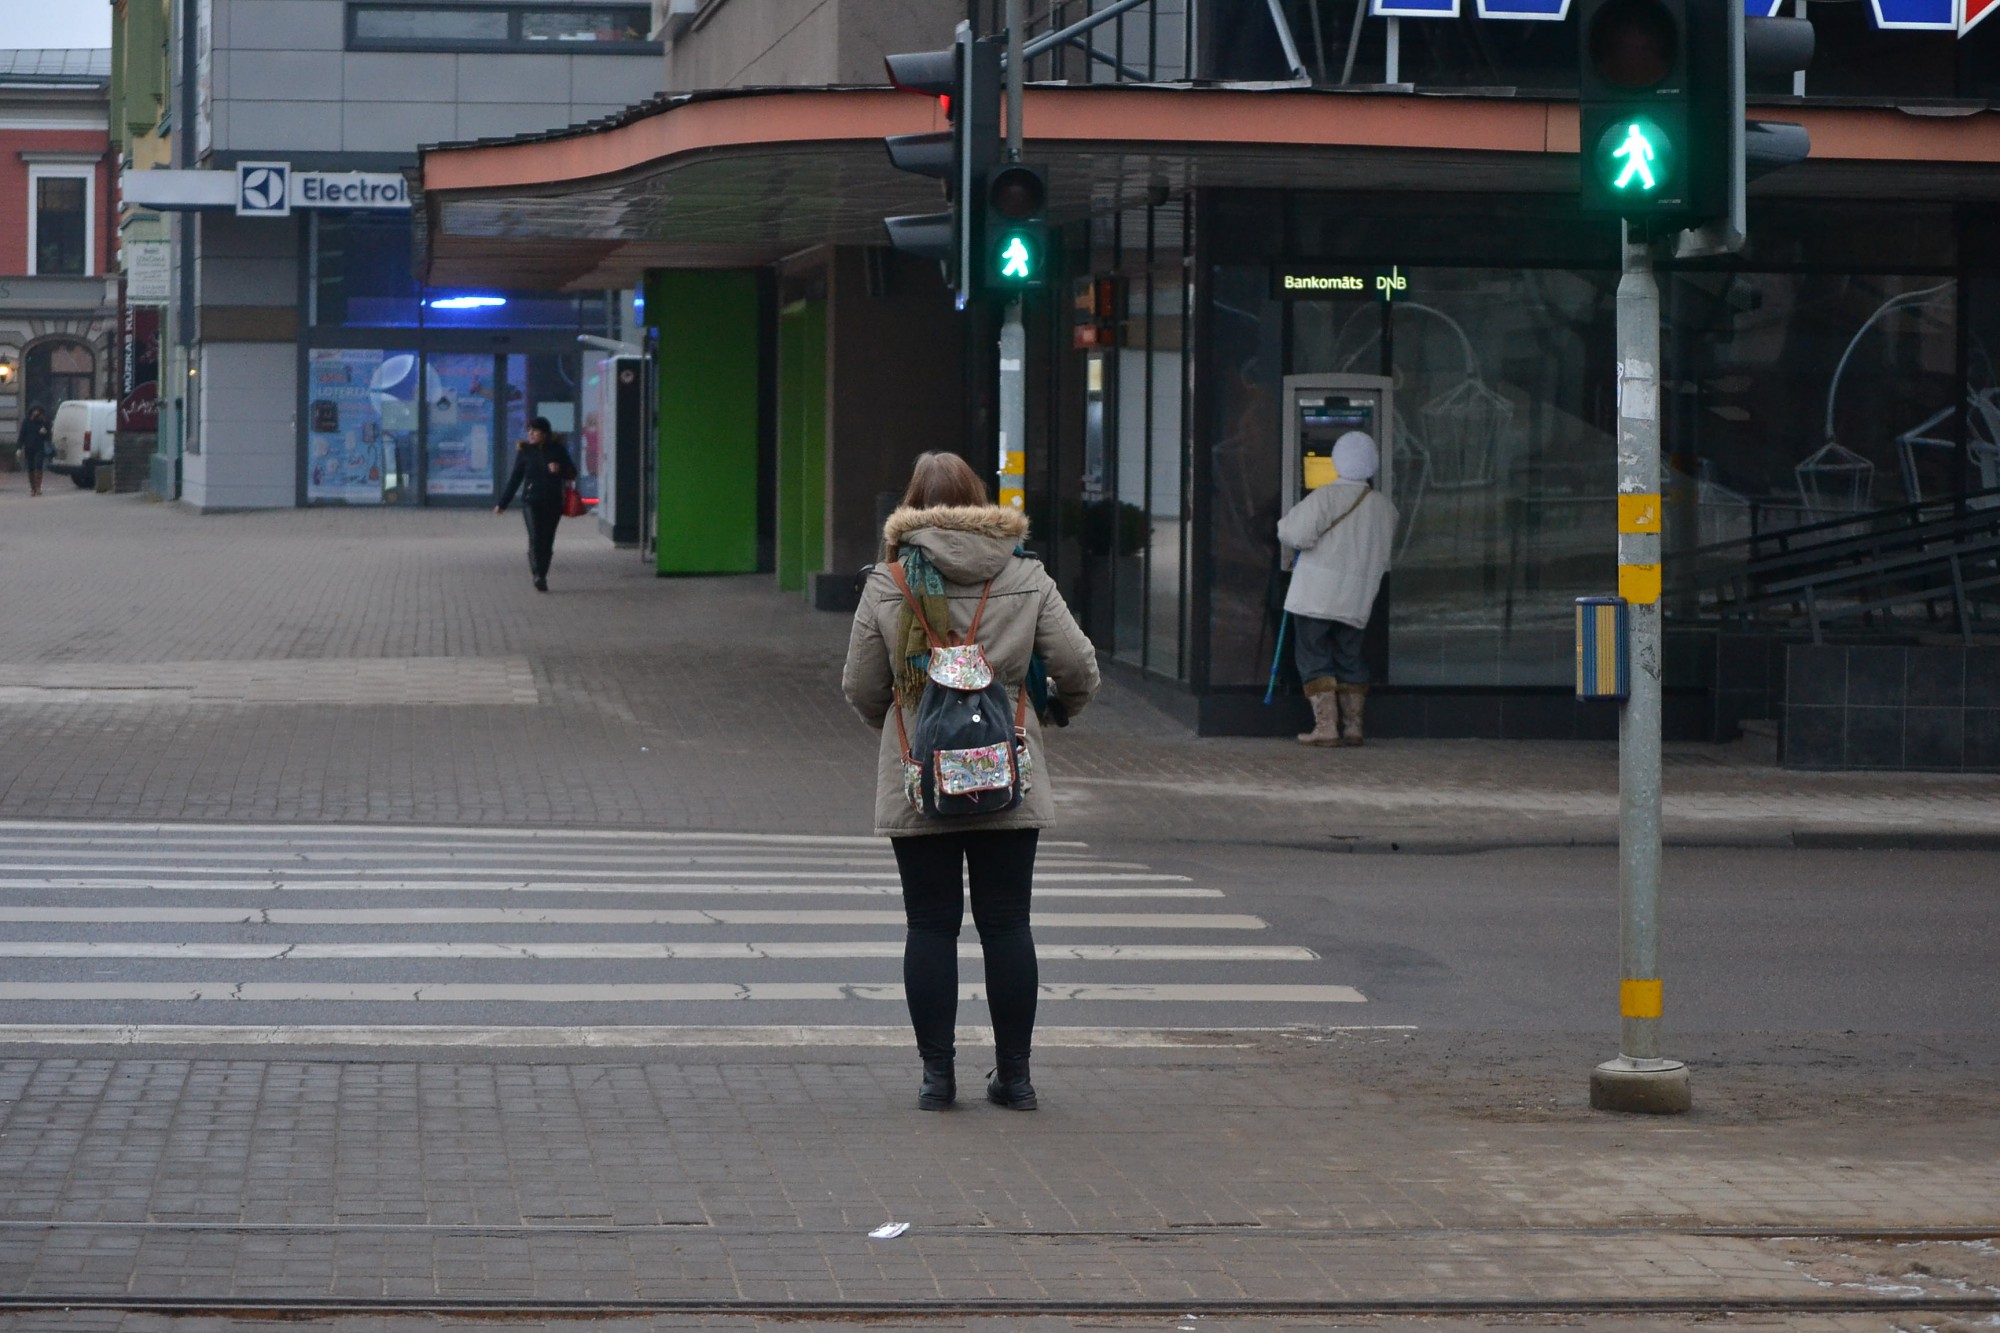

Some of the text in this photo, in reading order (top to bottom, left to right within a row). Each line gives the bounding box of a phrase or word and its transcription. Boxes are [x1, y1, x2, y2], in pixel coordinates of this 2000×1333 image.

[303, 178, 409, 201] Electrol
[1284, 265, 1407, 301] Bankomāts DNB
[125, 303, 134, 331] KLU
